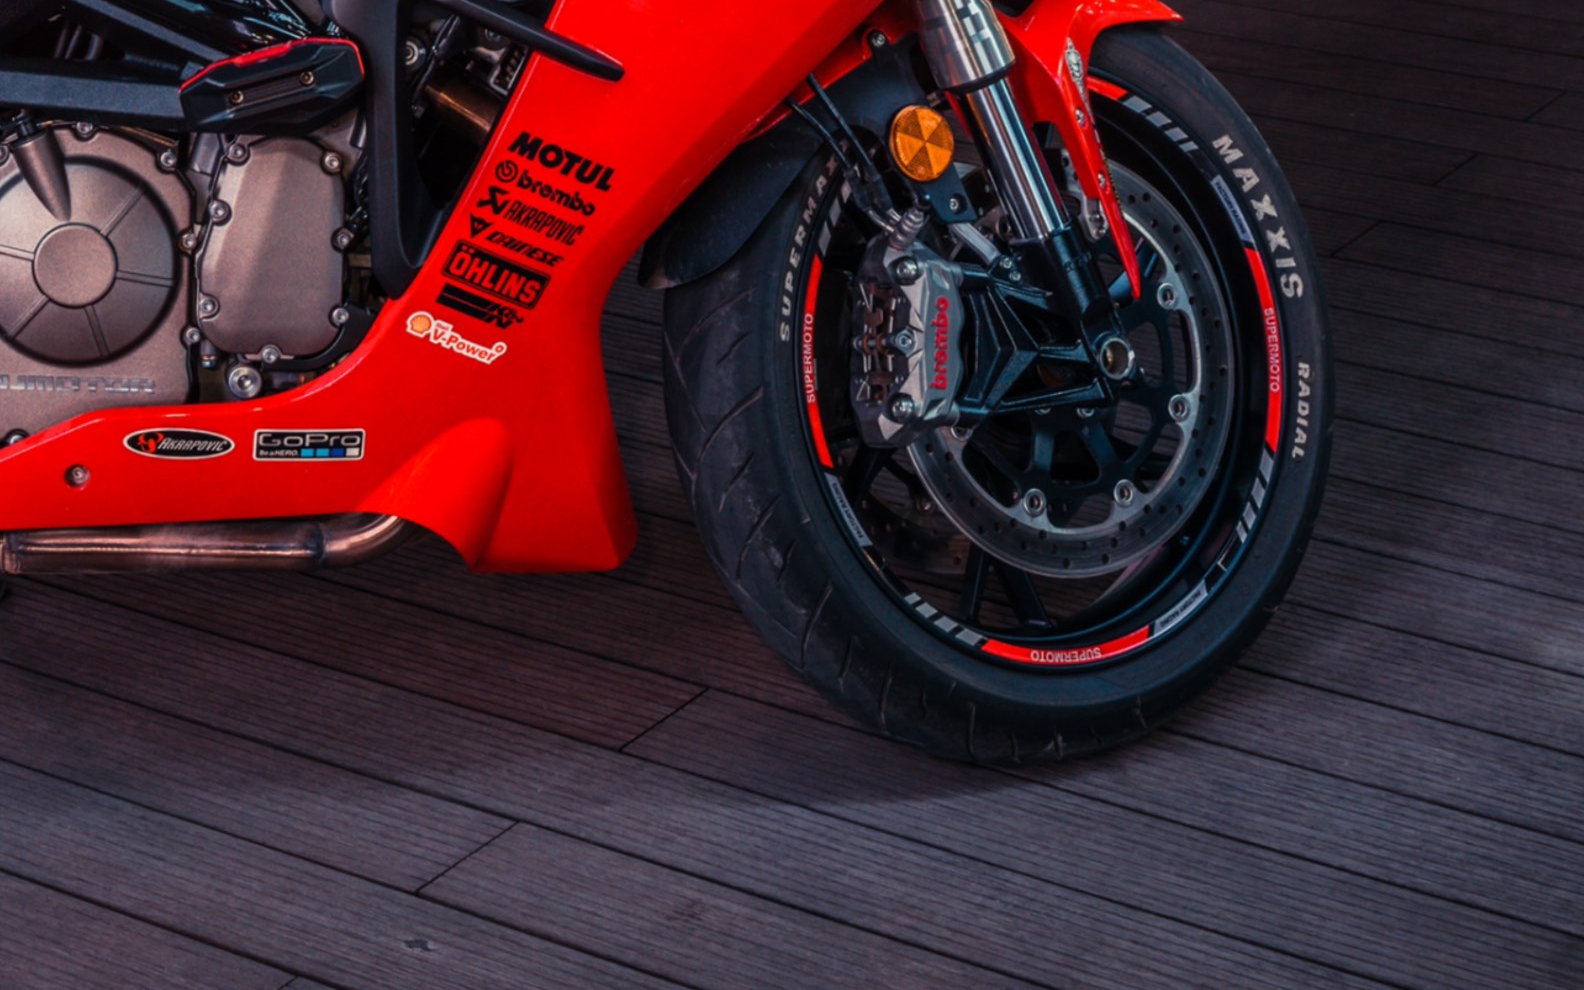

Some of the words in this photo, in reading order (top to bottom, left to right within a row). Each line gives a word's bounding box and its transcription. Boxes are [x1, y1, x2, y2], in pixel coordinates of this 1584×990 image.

[508, 131, 614, 192] MOTUL
[517, 170, 595, 216] brembo
[1212, 134, 1304, 298] MAXXIS
[486, 230, 564, 267] DAINESE
[433, 329, 496, 361] V-Power
[803, 313, 815, 403] SUPERMOTO
[930, 296, 950, 390] brembo
[1266, 307, 1281, 393] SUPERMOTO
[258, 433, 361, 447] GoPro
[1292, 362, 1311, 459] RADIAL
[1030, 647, 1102, 663] SUPERMOTO
